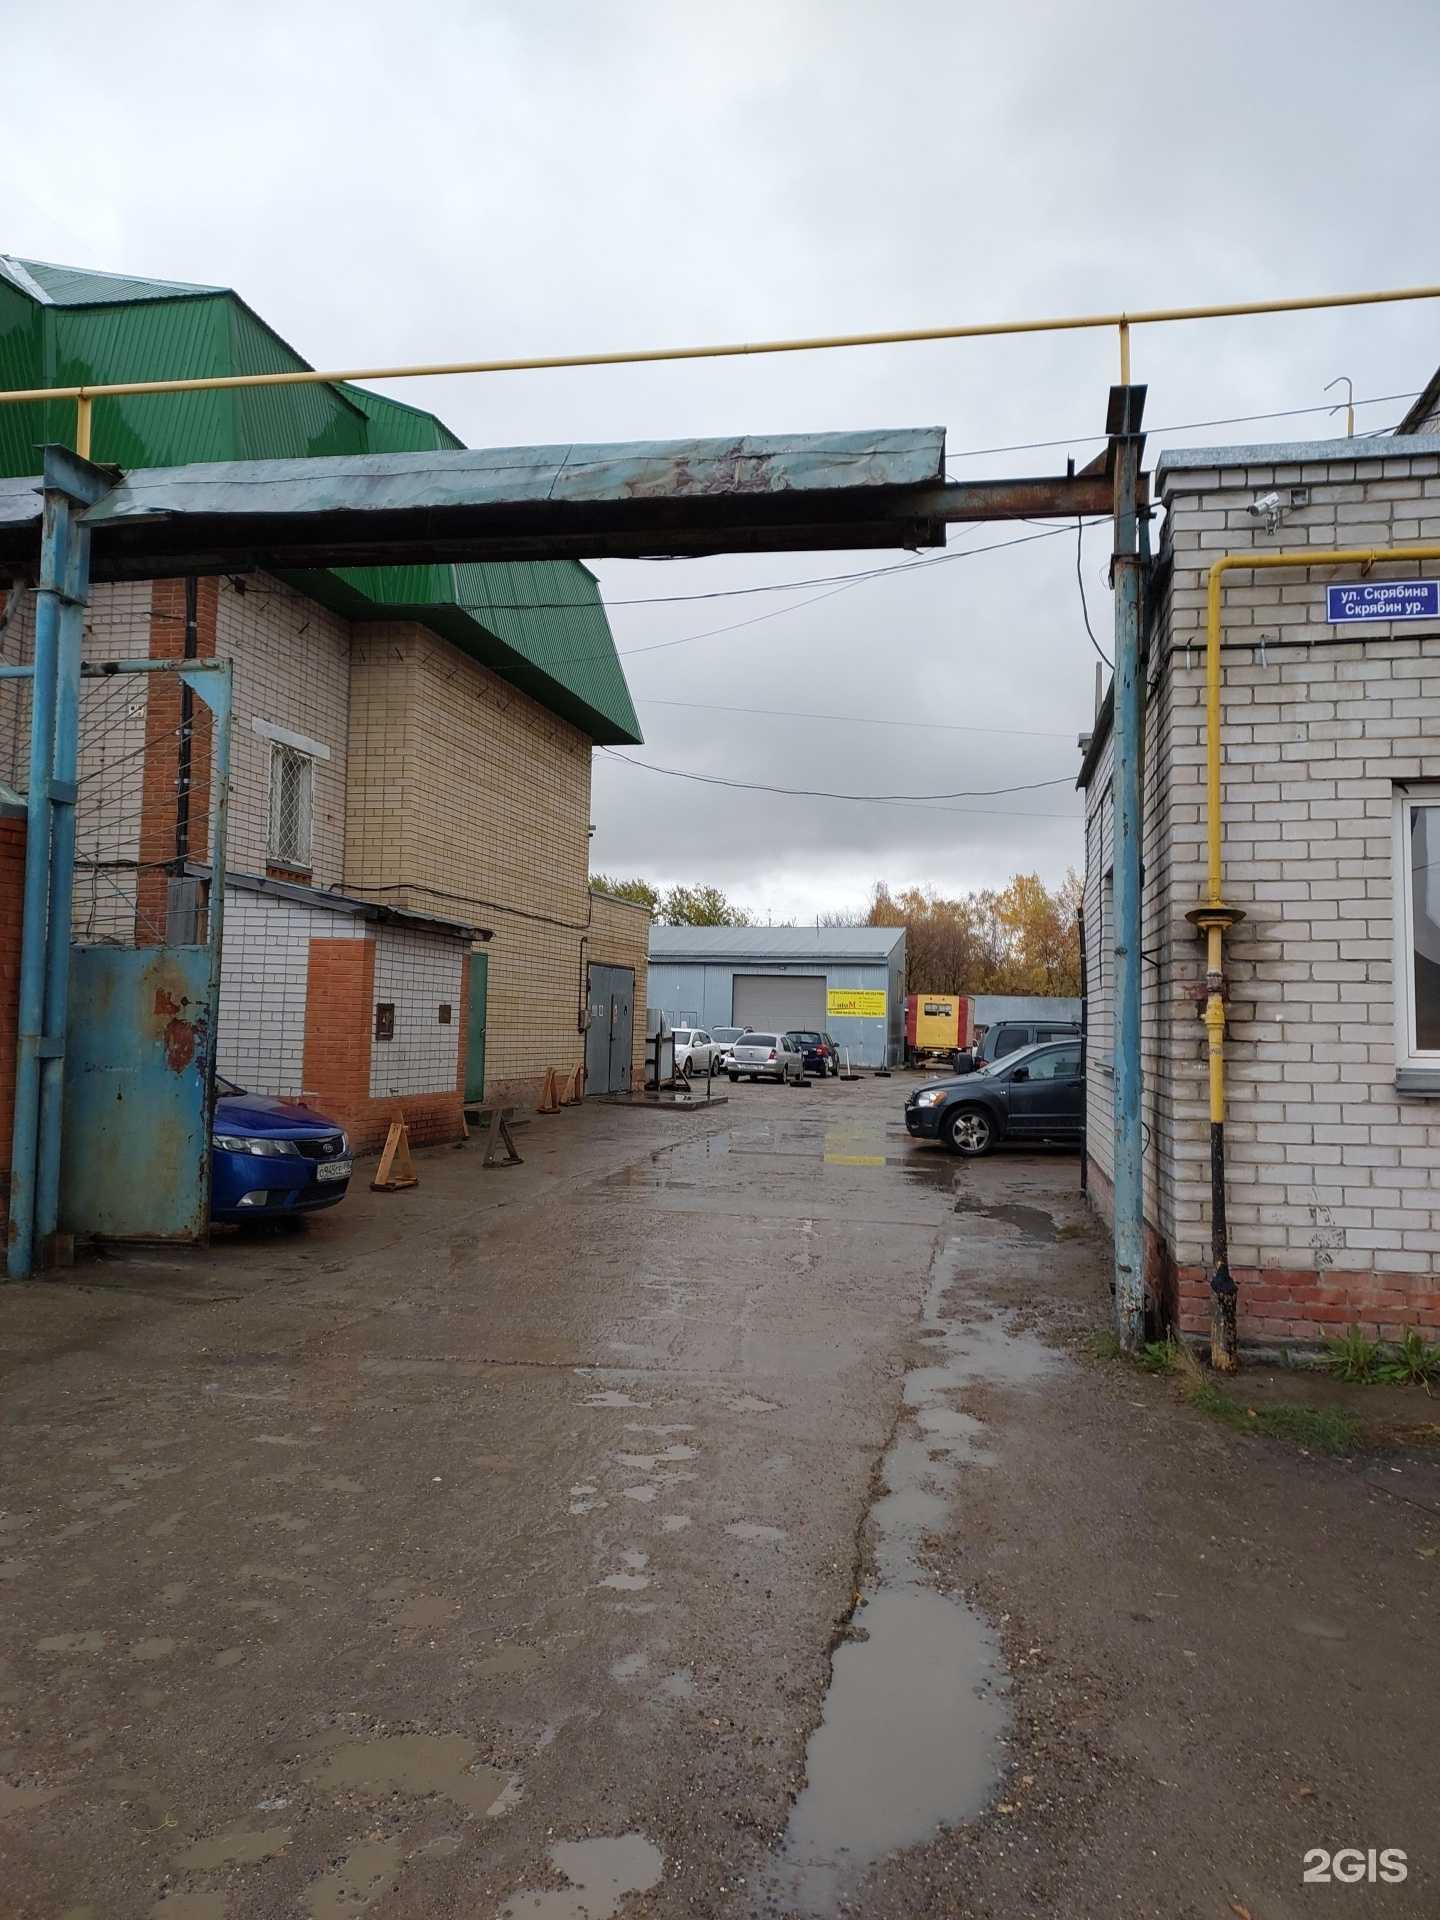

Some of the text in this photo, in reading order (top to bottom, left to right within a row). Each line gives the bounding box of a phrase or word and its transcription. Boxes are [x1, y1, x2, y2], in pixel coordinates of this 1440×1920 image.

[1341, 586, 1428, 603] ул. Скрябина
[1345, 601, 1425, 616] Скрябин ур.
